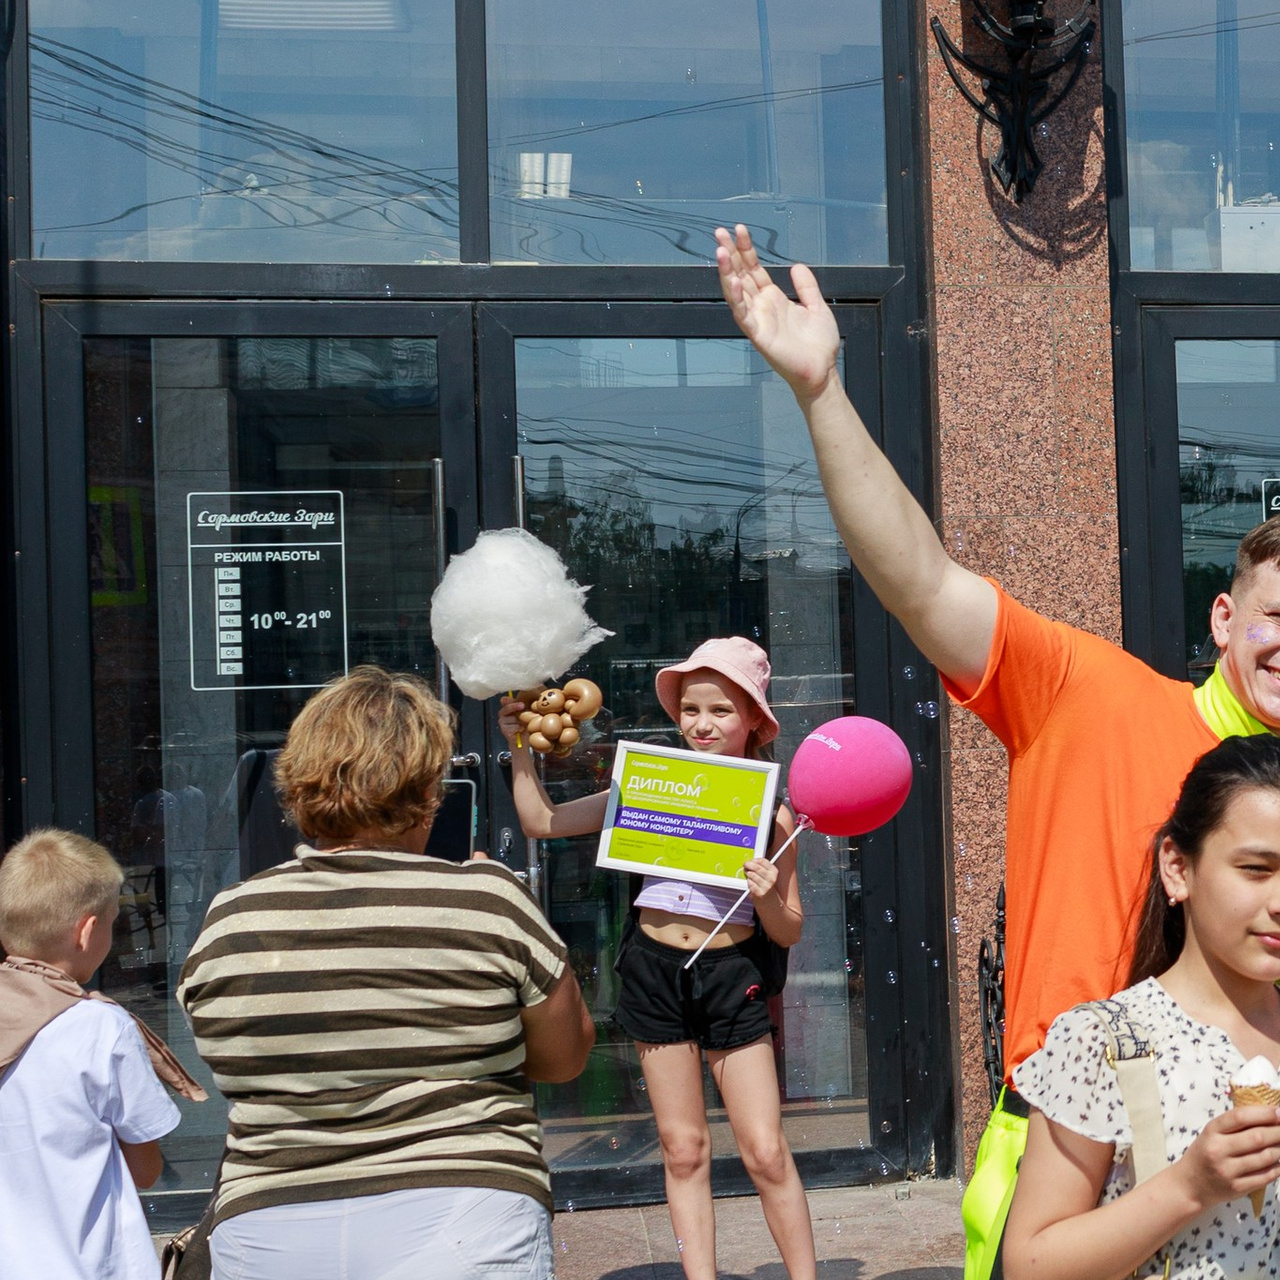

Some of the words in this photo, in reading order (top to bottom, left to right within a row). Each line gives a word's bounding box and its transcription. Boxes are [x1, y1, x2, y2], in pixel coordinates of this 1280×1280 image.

[197, 511, 290, 531] Сормовские
[294, 509, 335, 530] Зори
[214, 552, 262, 562] РЕЖИМ
[265, 551, 320, 562] РАБОТЫ
[626, 775, 701, 798] ДИПЛОМ
[620, 818, 649, 829] ЮНОМУ
[650, 823, 695, 836] КОНДИТЕРУ
[621, 810, 649, 821] ВЫДАН
[649, 814, 681, 826] САМОМУ
[682, 820, 743, 835] ТАЛАНТЛИВОМУ
